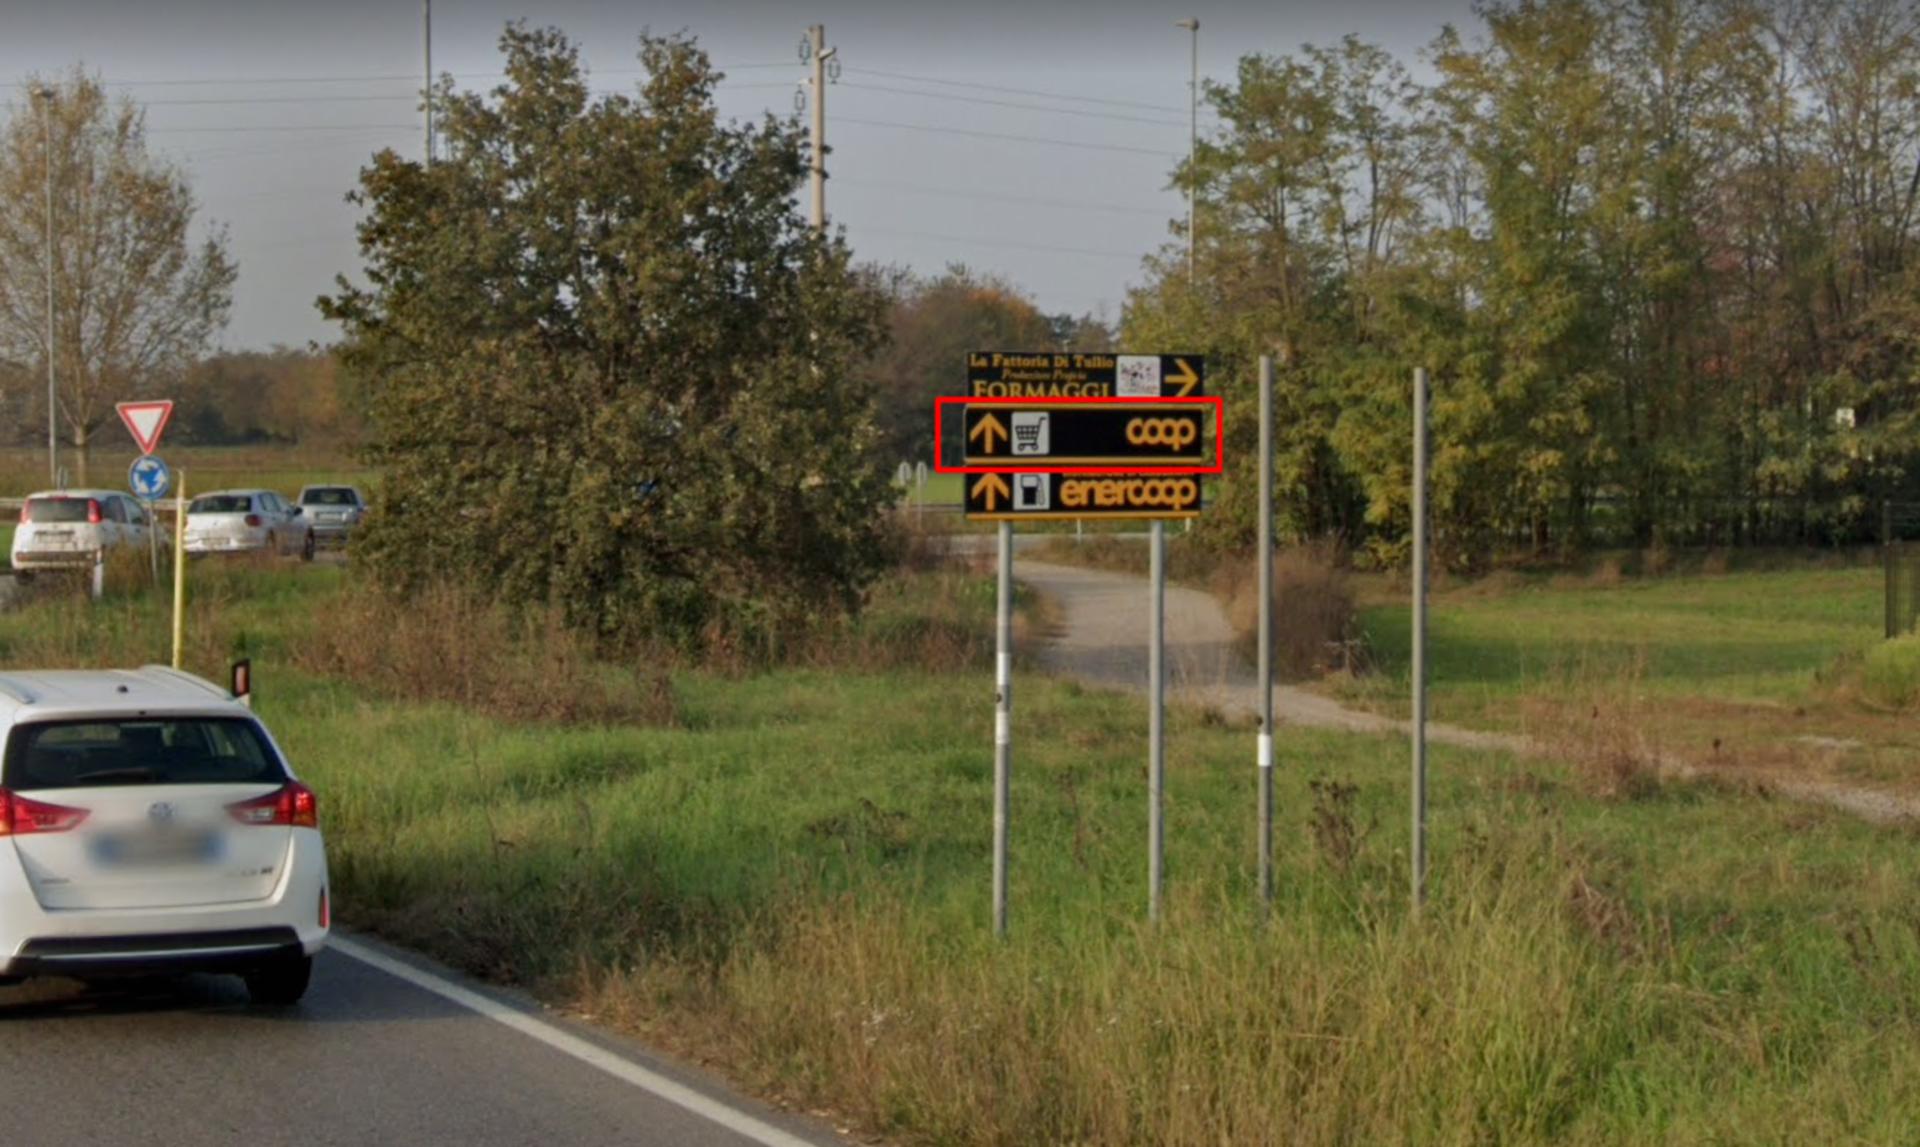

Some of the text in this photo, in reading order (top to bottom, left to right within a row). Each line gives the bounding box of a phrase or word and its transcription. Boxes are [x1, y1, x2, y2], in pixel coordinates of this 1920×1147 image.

[970, 353, 988, 368] La
[992, 353, 1049, 368] Fattoria
[1053, 355, 1069, 368] Di
[973, 380, 1110, 397] FORMAGGI
[1126, 418, 1196, 451] coop
[1060, 479, 1197, 511] enercoop
